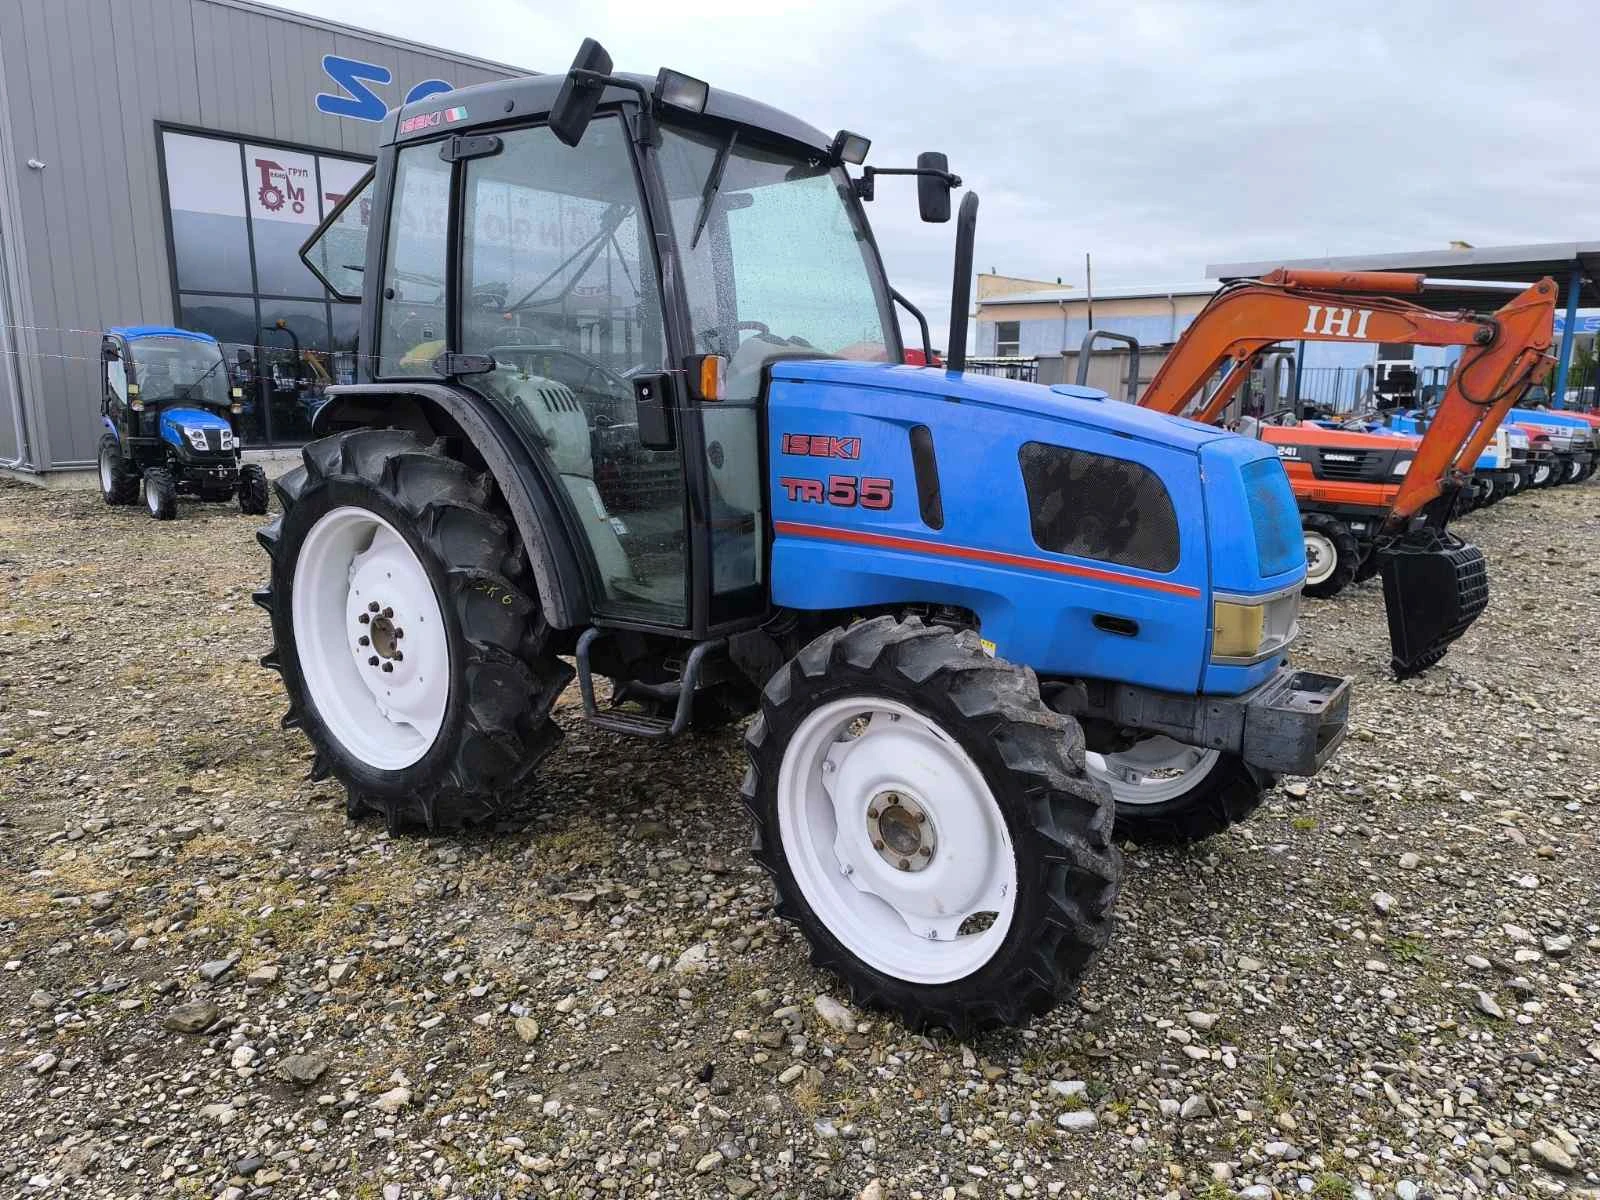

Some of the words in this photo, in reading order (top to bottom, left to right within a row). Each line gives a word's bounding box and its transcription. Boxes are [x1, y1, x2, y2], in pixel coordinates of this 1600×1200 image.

[400, 112, 441, 134] ISEKI
[1303, 305, 1374, 338] IHI
[782, 433, 862, 460] ISEKI
